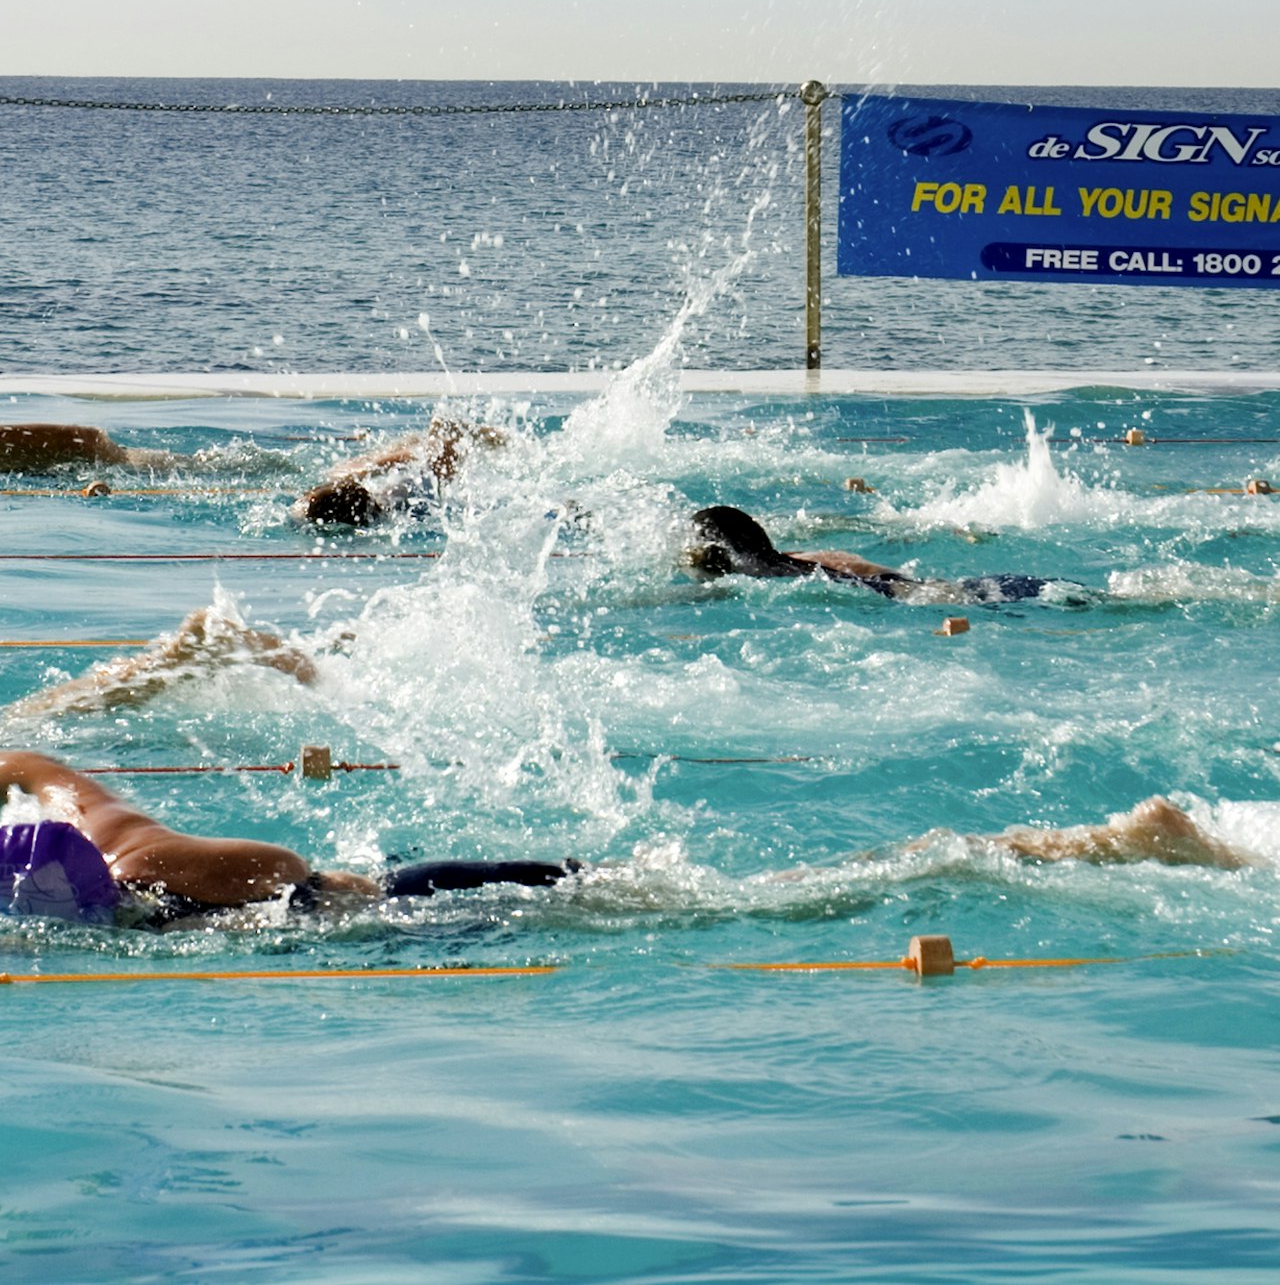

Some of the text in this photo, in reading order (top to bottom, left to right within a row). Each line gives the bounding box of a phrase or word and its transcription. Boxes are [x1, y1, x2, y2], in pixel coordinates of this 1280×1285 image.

[1029, 136, 1070, 159] de
[1073, 122, 1267, 164] SIGN
[911, 182, 987, 213] FOR
[998, 185, 1062, 216] ALL
[1079, 187, 1173, 219] YOUR
[1025, 248, 1099, 270] FREE
[1109, 250, 1183, 272] CALL:
[1192, 253, 1262, 275] 1800
